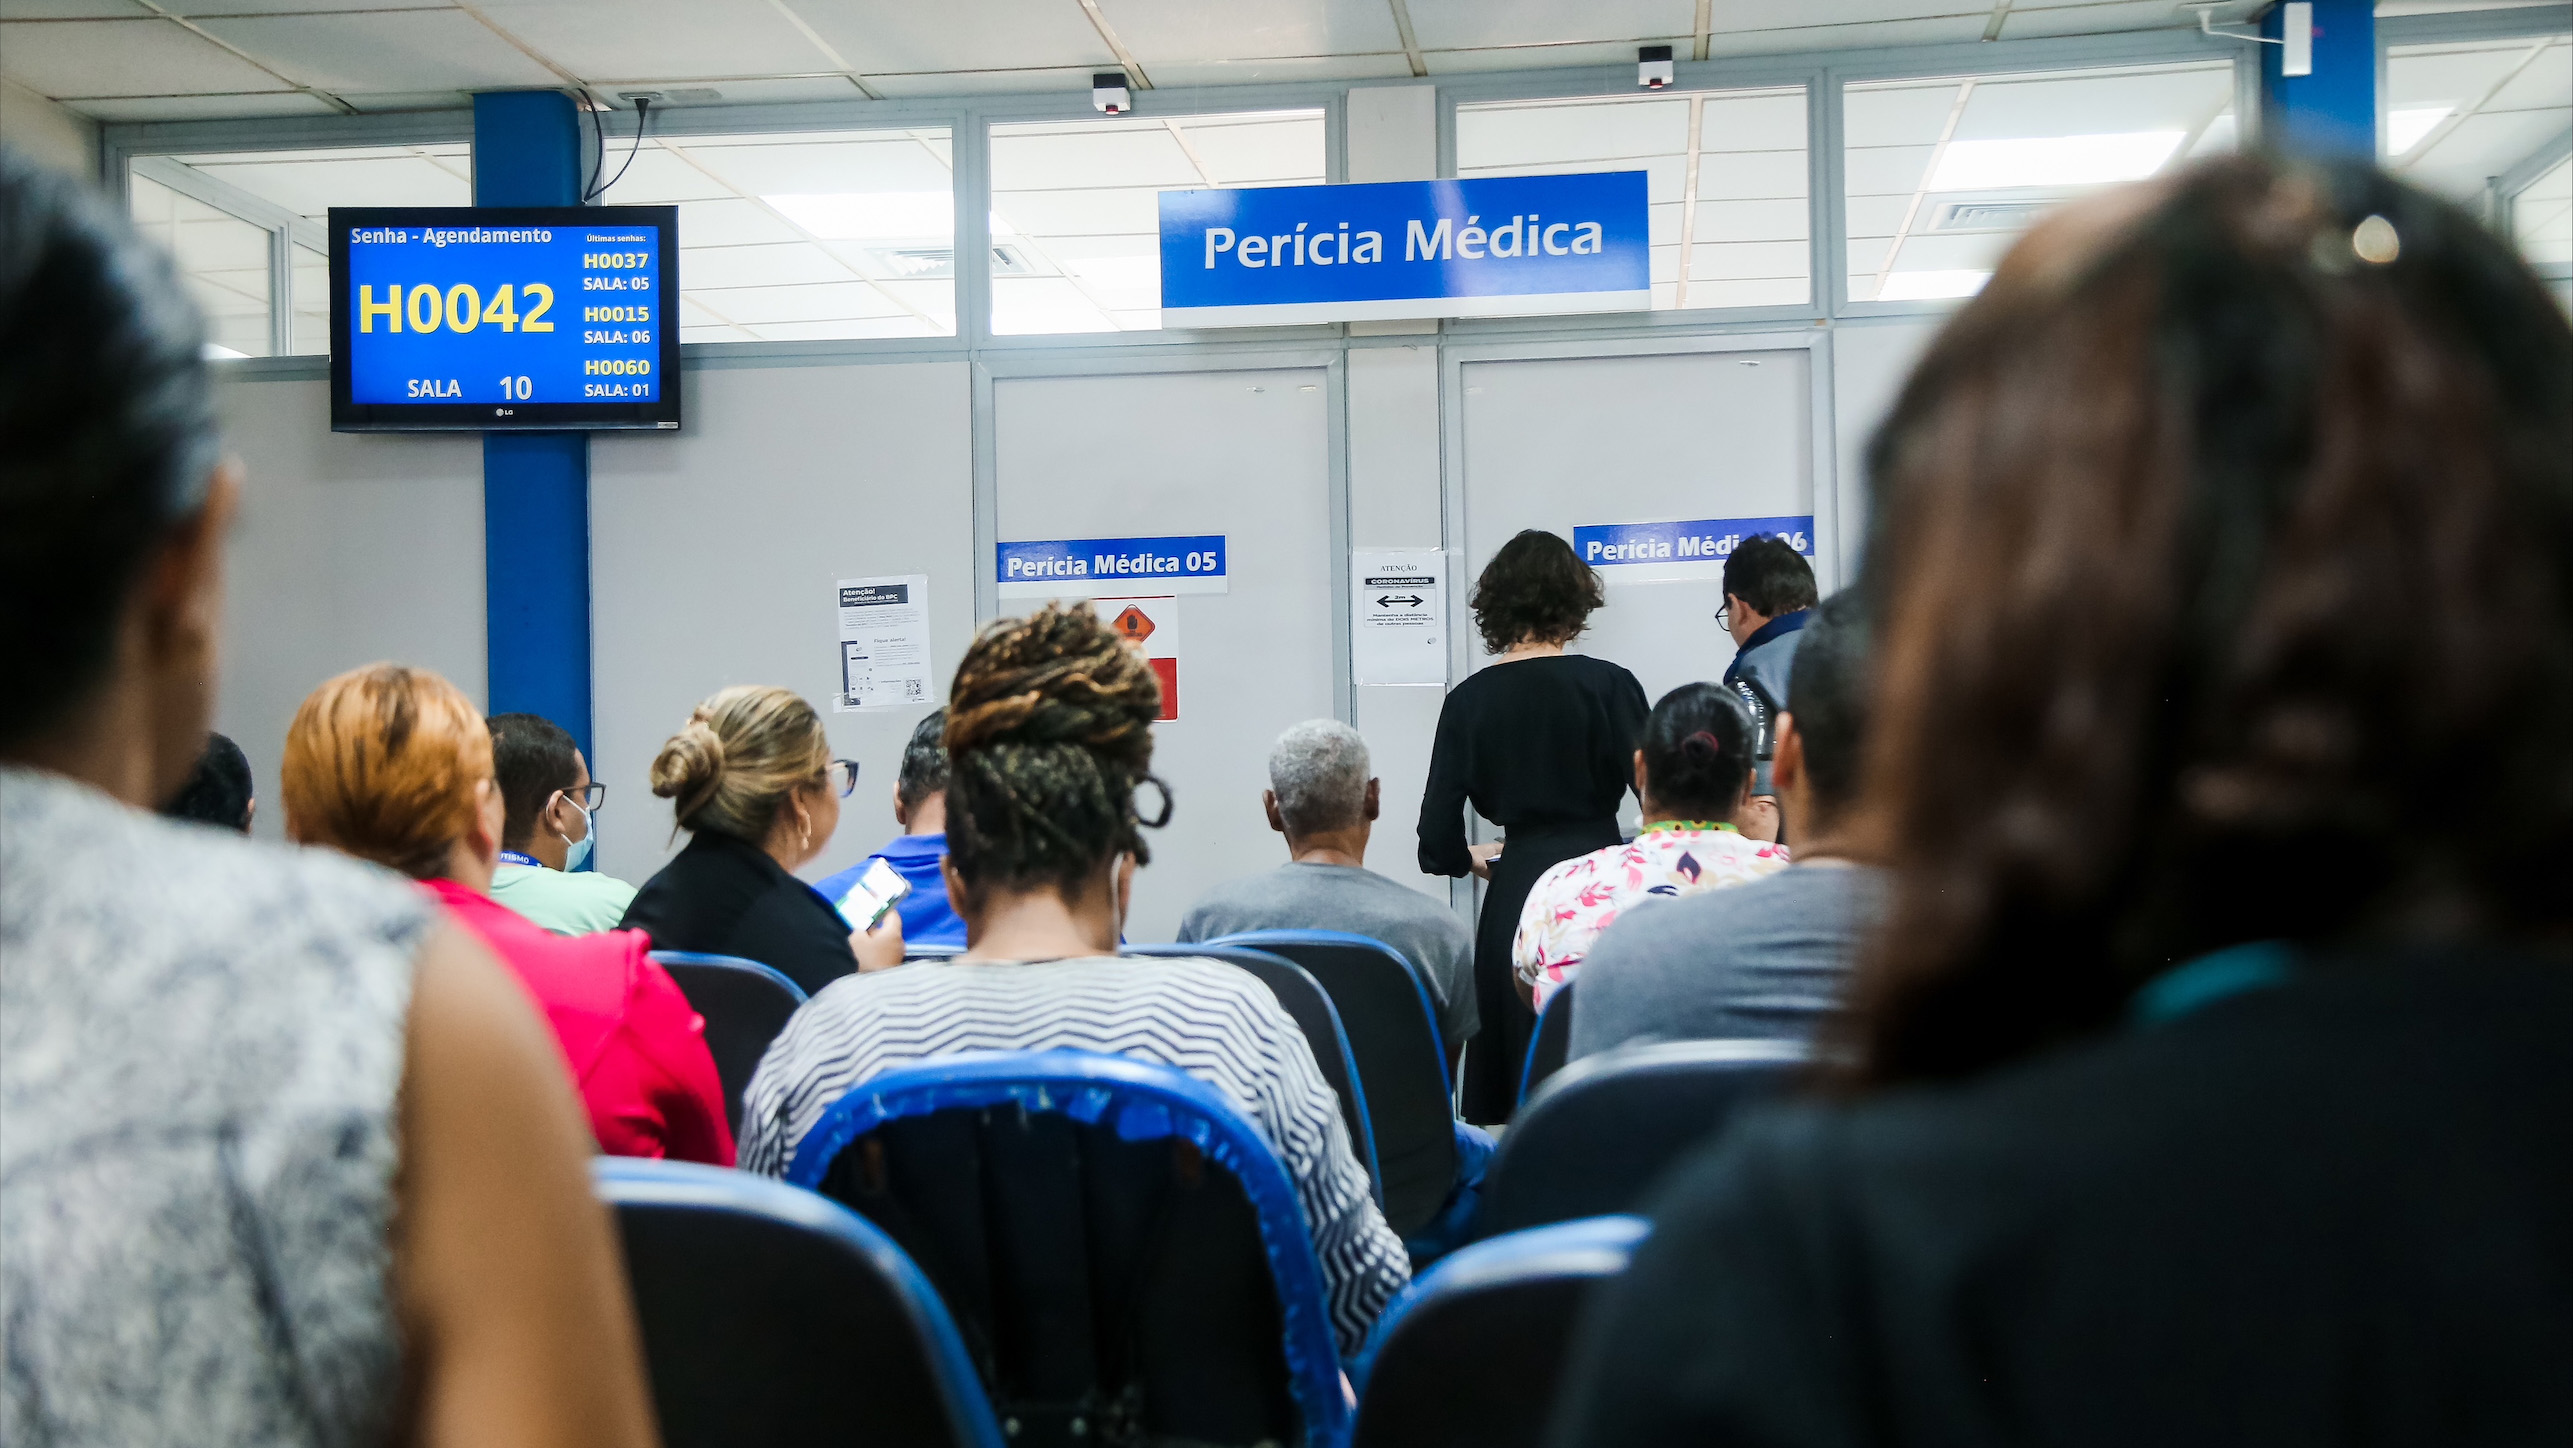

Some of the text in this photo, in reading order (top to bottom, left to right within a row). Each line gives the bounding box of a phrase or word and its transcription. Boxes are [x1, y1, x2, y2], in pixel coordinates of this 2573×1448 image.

[351, 228, 407, 244] Senha
[423, 228, 552, 247] Agendamento
[587, 233, 646, 243] Últimas senhas:
[1205, 213, 1602, 270] Perícia Médica
[584, 253, 649, 269] H0037
[584, 278, 650, 291] SALA: 05
[359, 283, 555, 334] H0042
[585, 306, 649, 323] H0015
[584, 330, 650, 344] SALA: 06
[585, 360, 650, 376] H0060
[408, 376, 533, 401] SALA 10
[584, 383, 649, 397] SALA: 01
[1587, 539, 1670, 561] Perícia
[1678, 535, 1740, 557] Médi
[1008, 551, 1216, 577] Perícia Médica 05
[1381, 564, 1417, 572] ATENÇÃO
